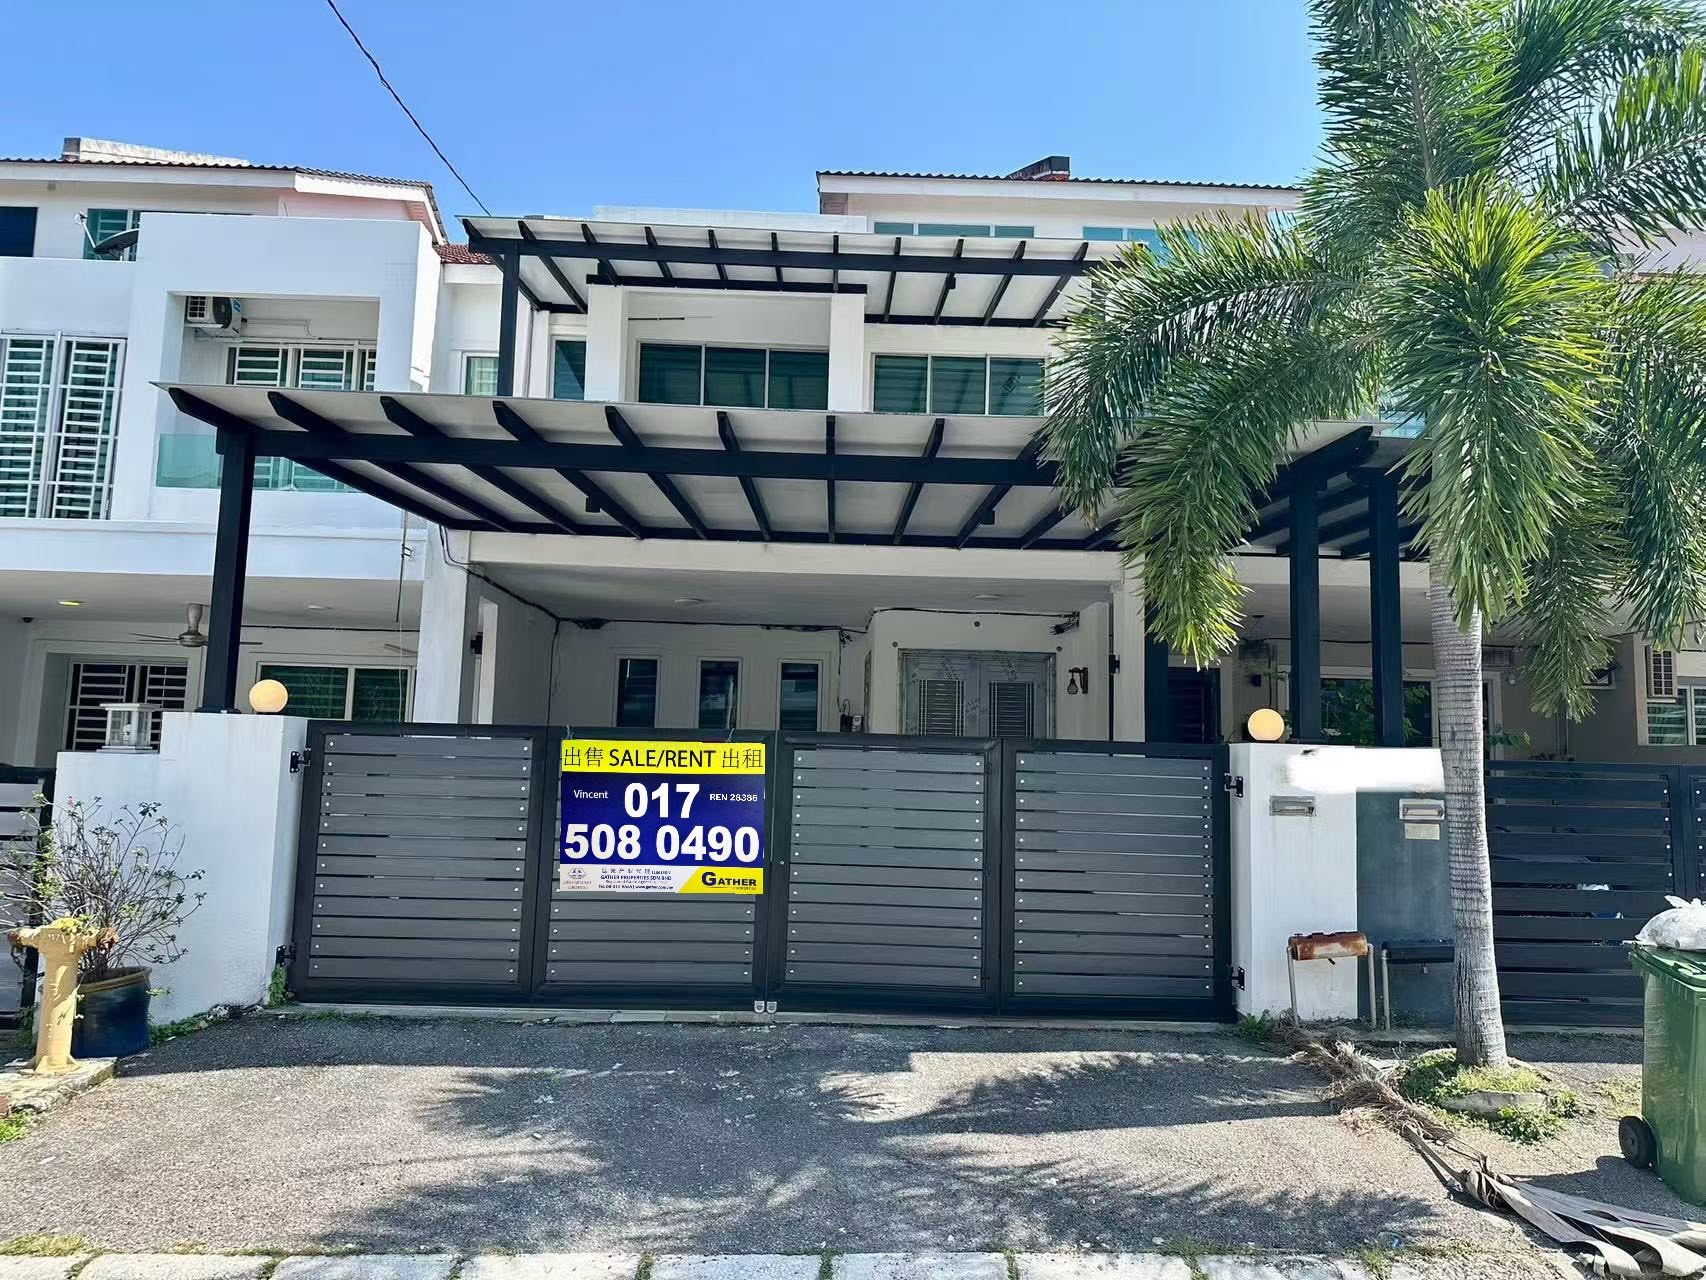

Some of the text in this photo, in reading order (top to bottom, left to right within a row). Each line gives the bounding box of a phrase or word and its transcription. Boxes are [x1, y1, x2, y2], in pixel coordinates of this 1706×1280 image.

[564, 746, 603, 767] 出售
[609, 748, 716, 768] SALE/RENT
[722, 748, 763, 769] 出租
[573, 789, 608, 799] Vincent
[624, 782, 700, 818] 017
[709, 793, 758, 801] REN 28386
[564, 823, 760, 863] 508 0490
[701, 871, 757, 887] GATHER
